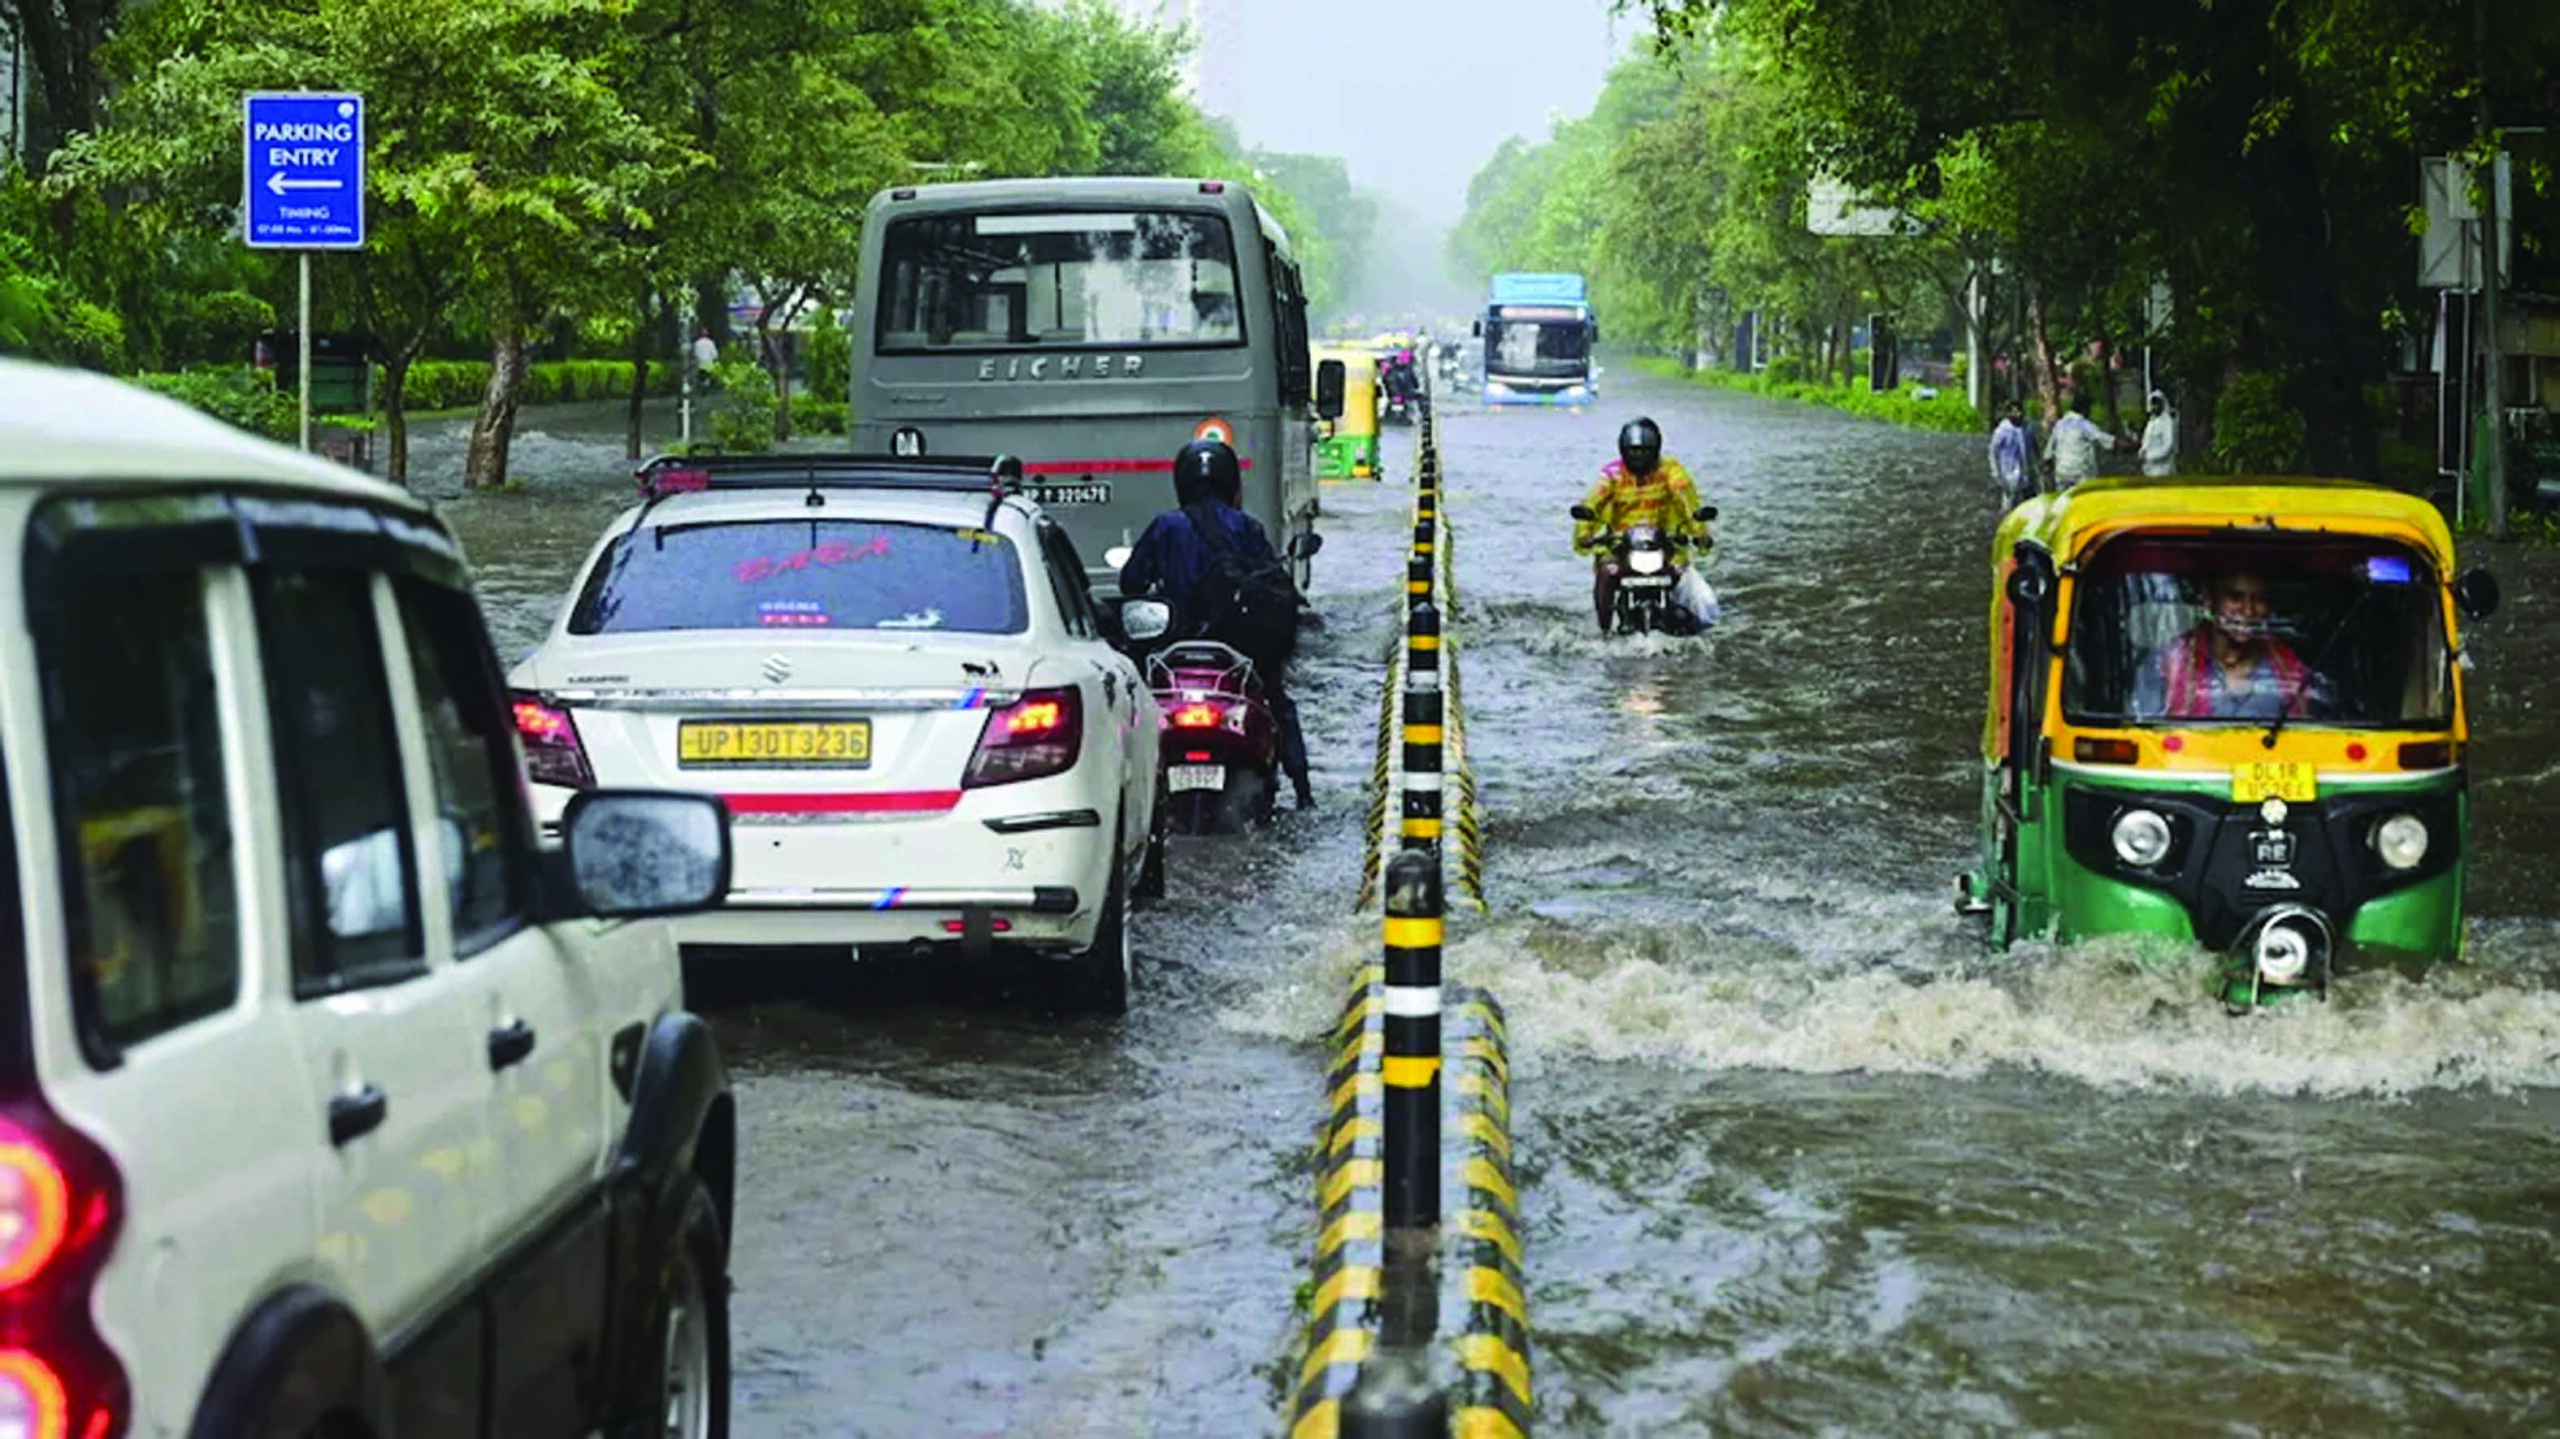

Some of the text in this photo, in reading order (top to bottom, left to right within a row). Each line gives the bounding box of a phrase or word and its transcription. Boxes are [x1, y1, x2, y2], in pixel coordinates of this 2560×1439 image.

[254, 122, 352, 142] PARKING
[269, 148, 339, 166] ENTRY
[279, 206, 330, 219] TIMING
[978, 354, 1144, 381] EICHER
[896, 431, 920, 456] DA
[697, 728, 865, 755] UP13DT3236
[2256, 843, 2287, 861] RE
